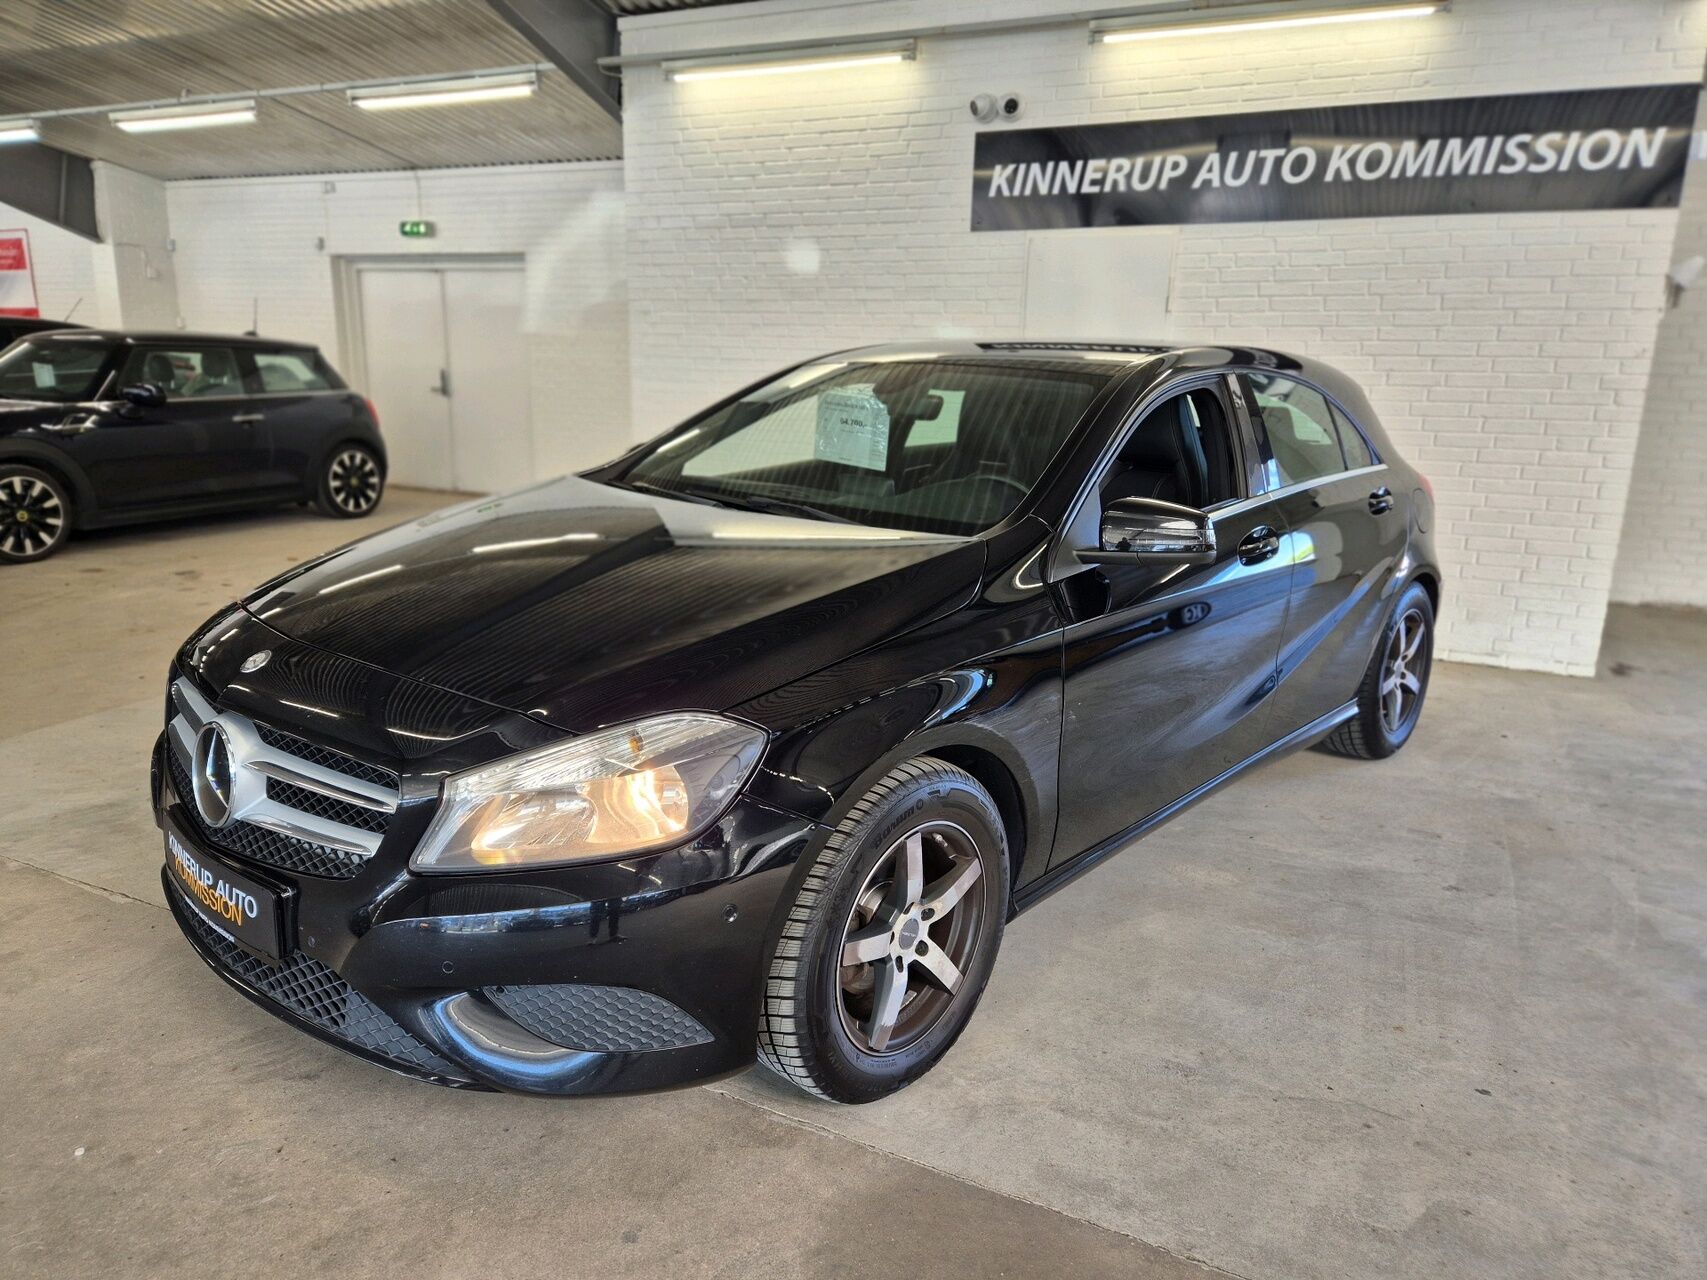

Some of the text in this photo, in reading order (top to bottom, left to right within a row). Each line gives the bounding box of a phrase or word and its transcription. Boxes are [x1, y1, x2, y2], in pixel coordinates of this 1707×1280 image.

[988, 126, 1668, 197] KINNERUP AUTO KOMMISSION
[175, 858, 243, 927] KOMMISSION
[215, 879, 258, 919] AUTO
